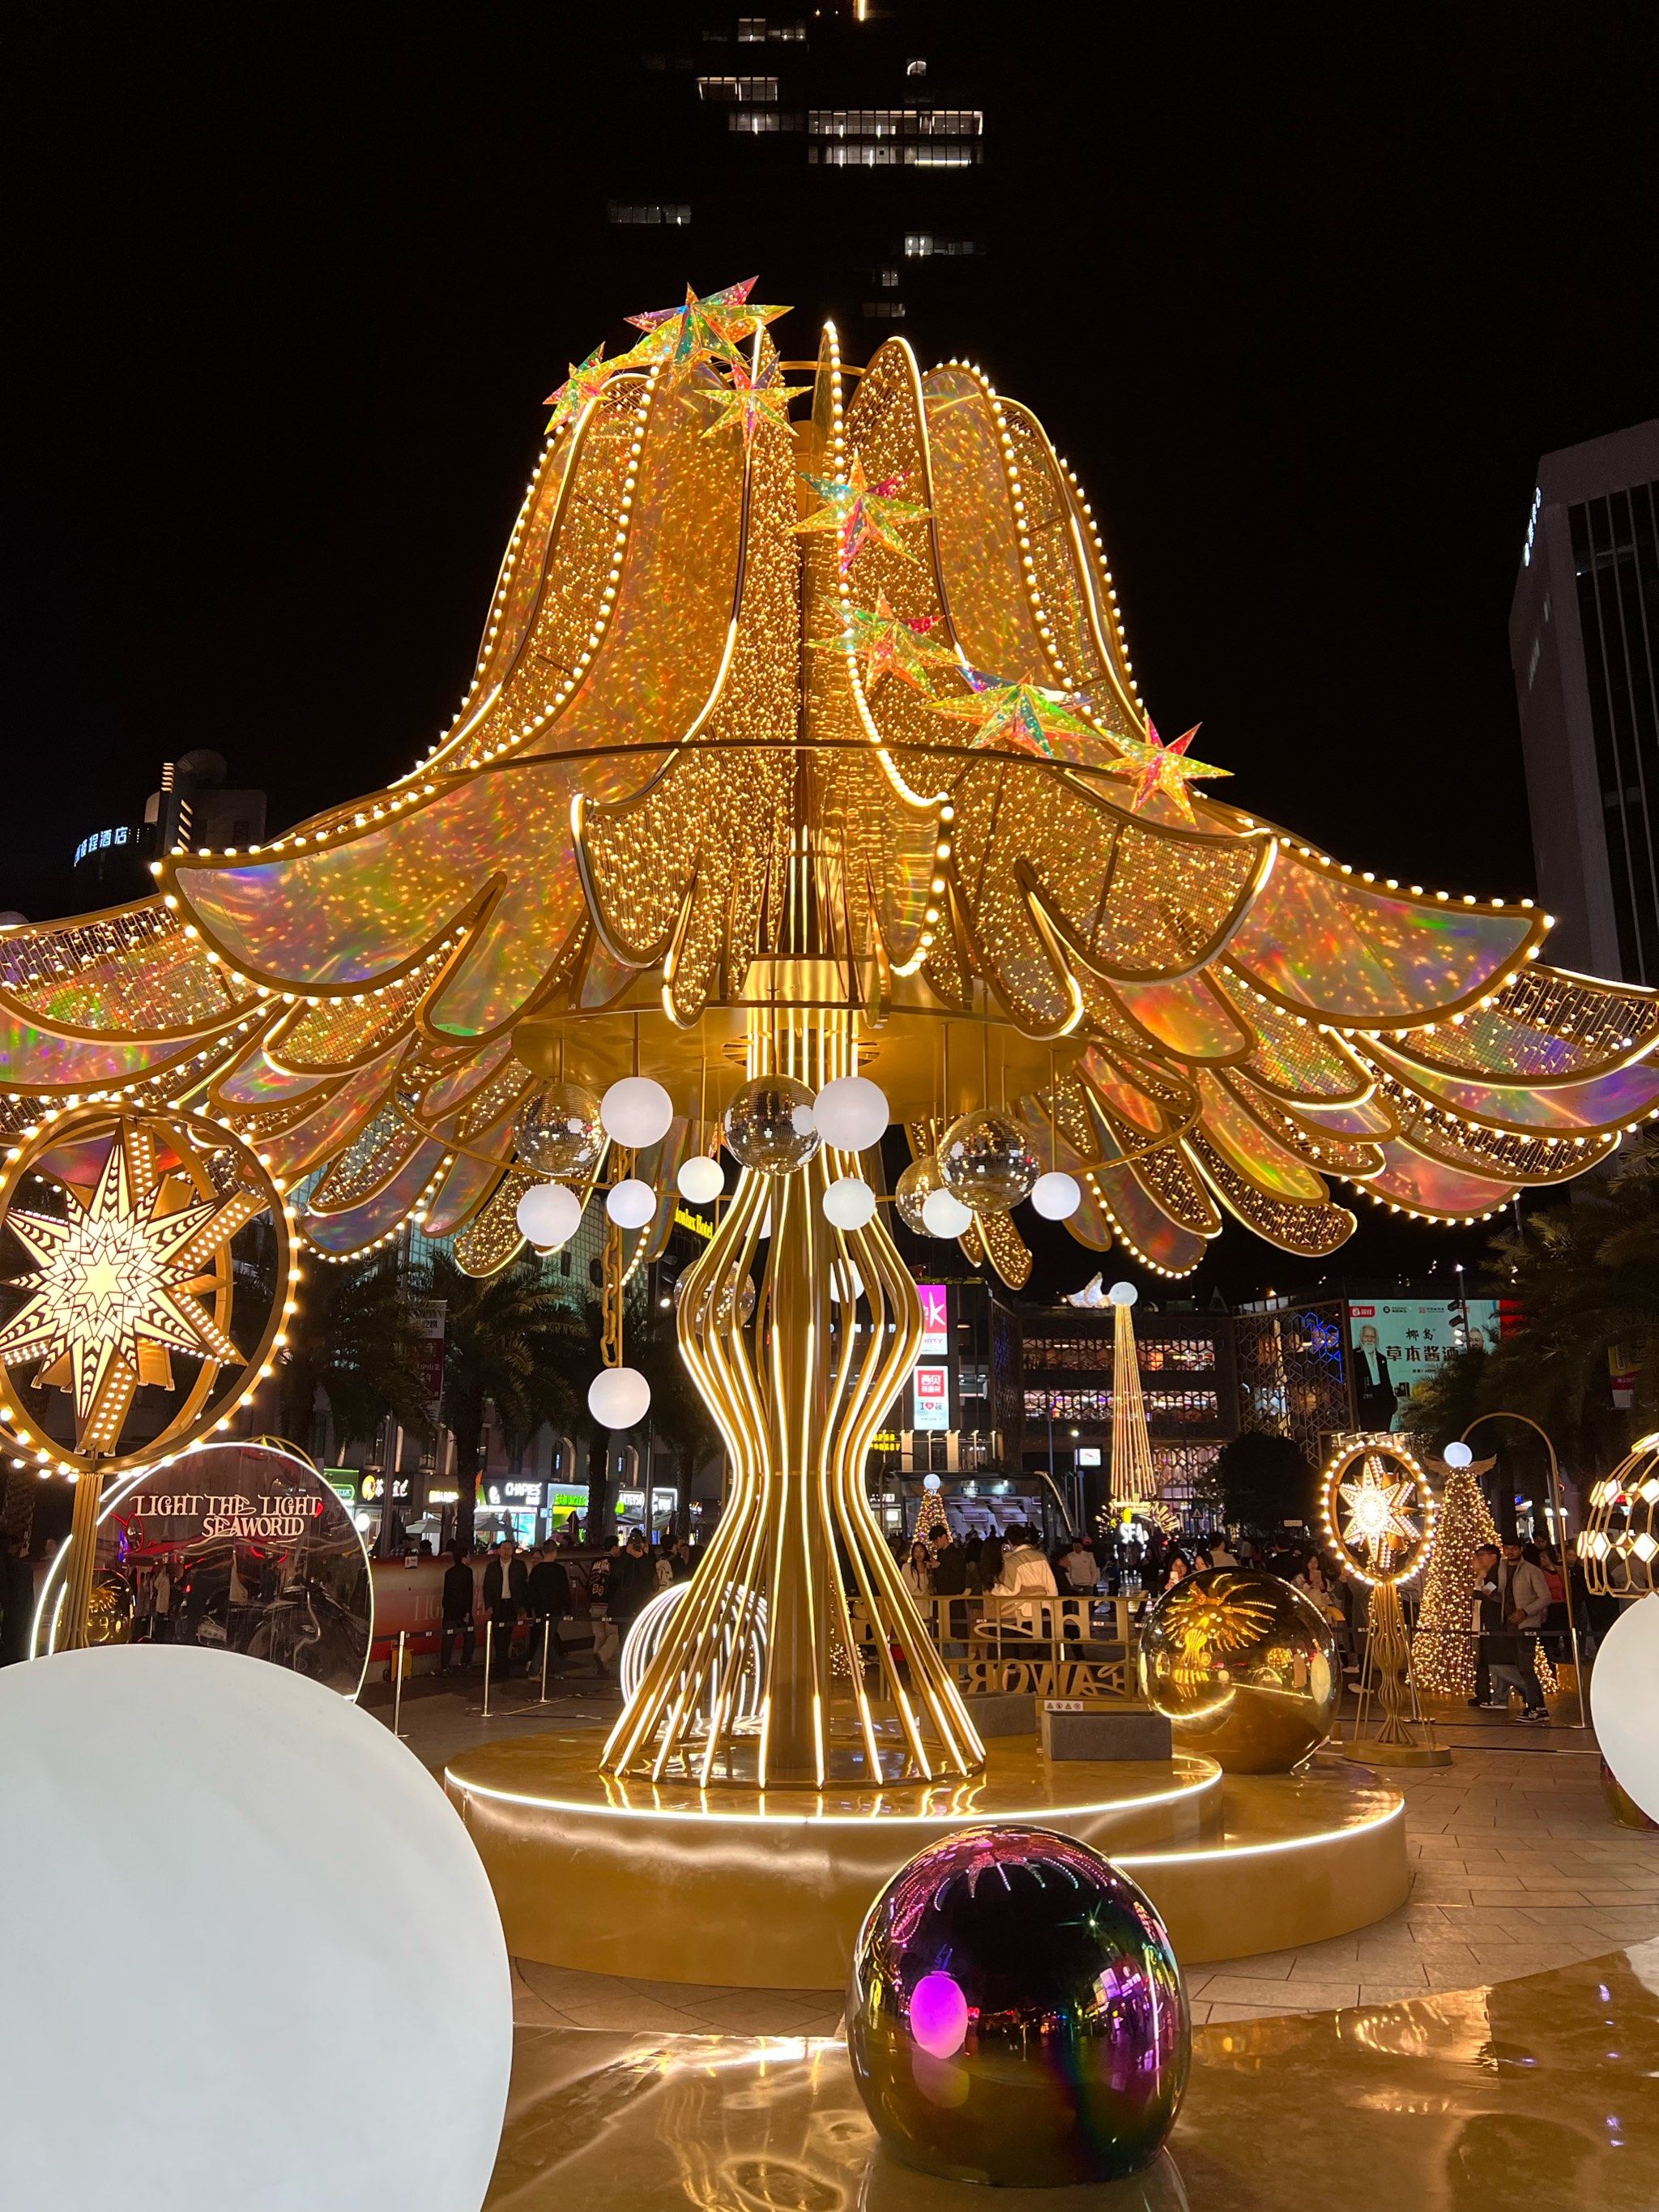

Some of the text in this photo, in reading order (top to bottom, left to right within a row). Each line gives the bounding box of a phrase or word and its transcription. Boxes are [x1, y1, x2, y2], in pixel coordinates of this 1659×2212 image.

[696, 1214, 714, 1241] Hotel
[1386, 1345, 1459, 1362] 草本酱酒
[130, 1493, 322, 1516] LIGHT THE LIGHT
